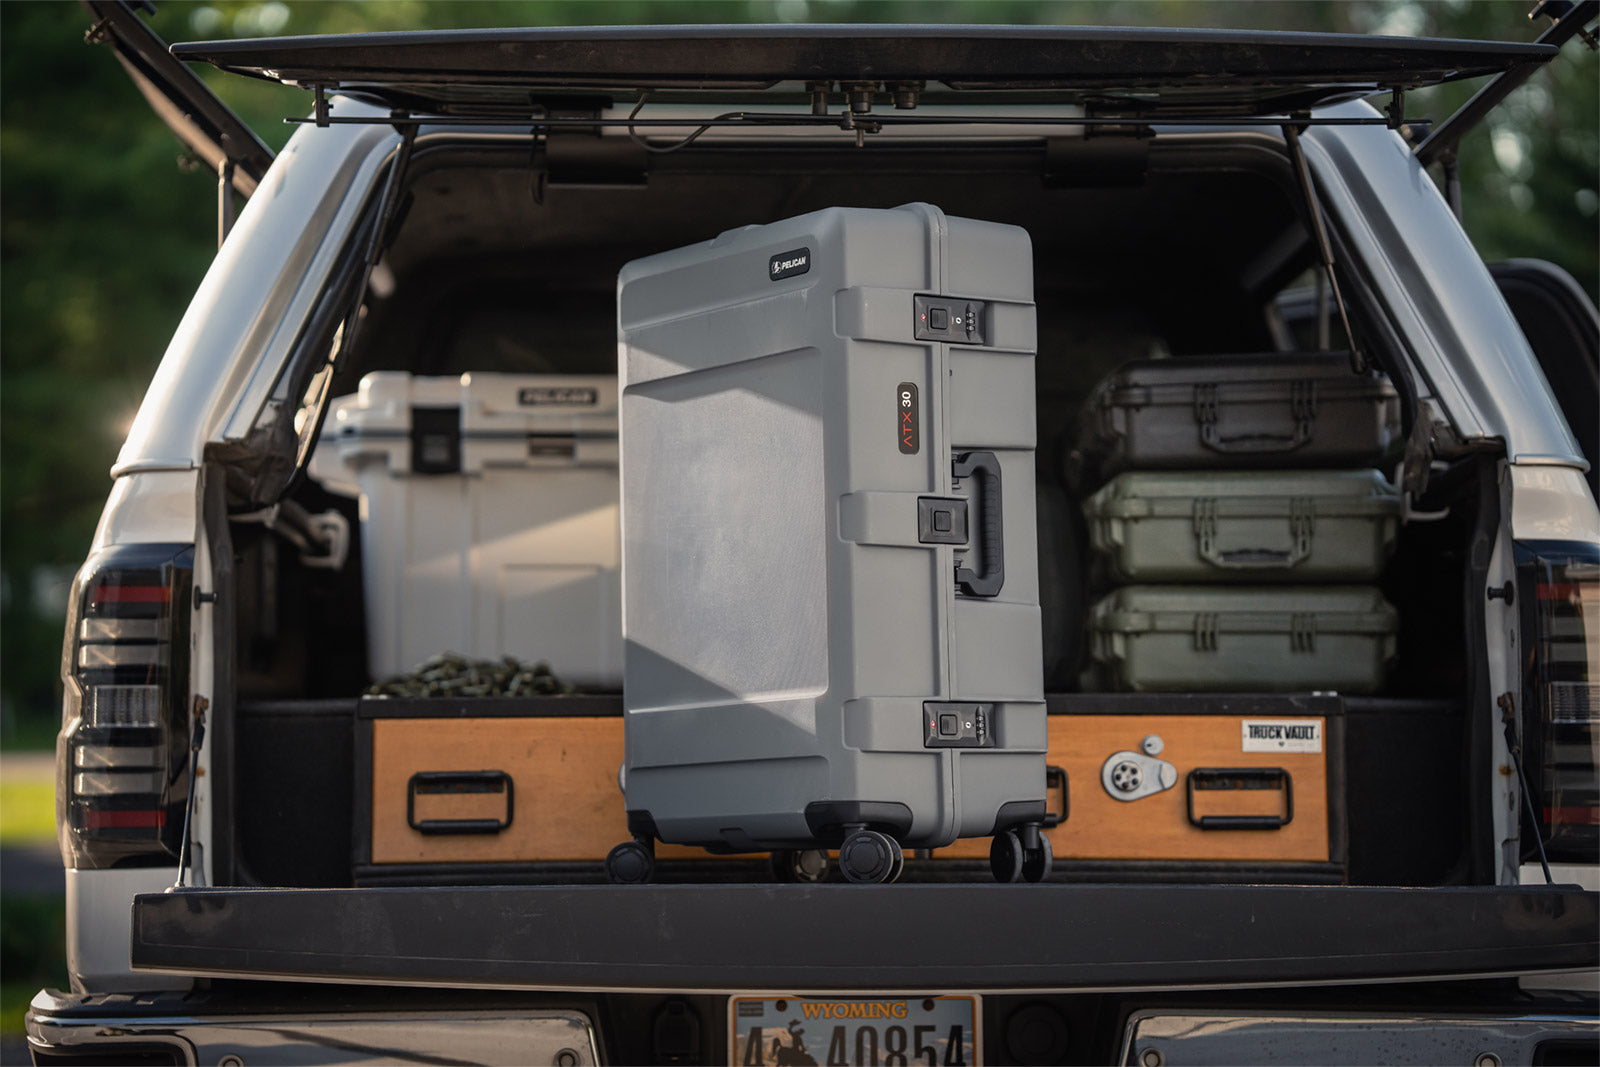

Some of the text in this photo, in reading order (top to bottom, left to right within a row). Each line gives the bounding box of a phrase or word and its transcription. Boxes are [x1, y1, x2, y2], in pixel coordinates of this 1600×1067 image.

[781, 256, 807, 270] PELICAN
[901, 391, 913, 448] ATX 30
[1248, 725, 1316, 740] TRUCK VAULT
[801, 1001, 909, 1020] WYOMING
[826, 1025, 968, 1067] 40854
